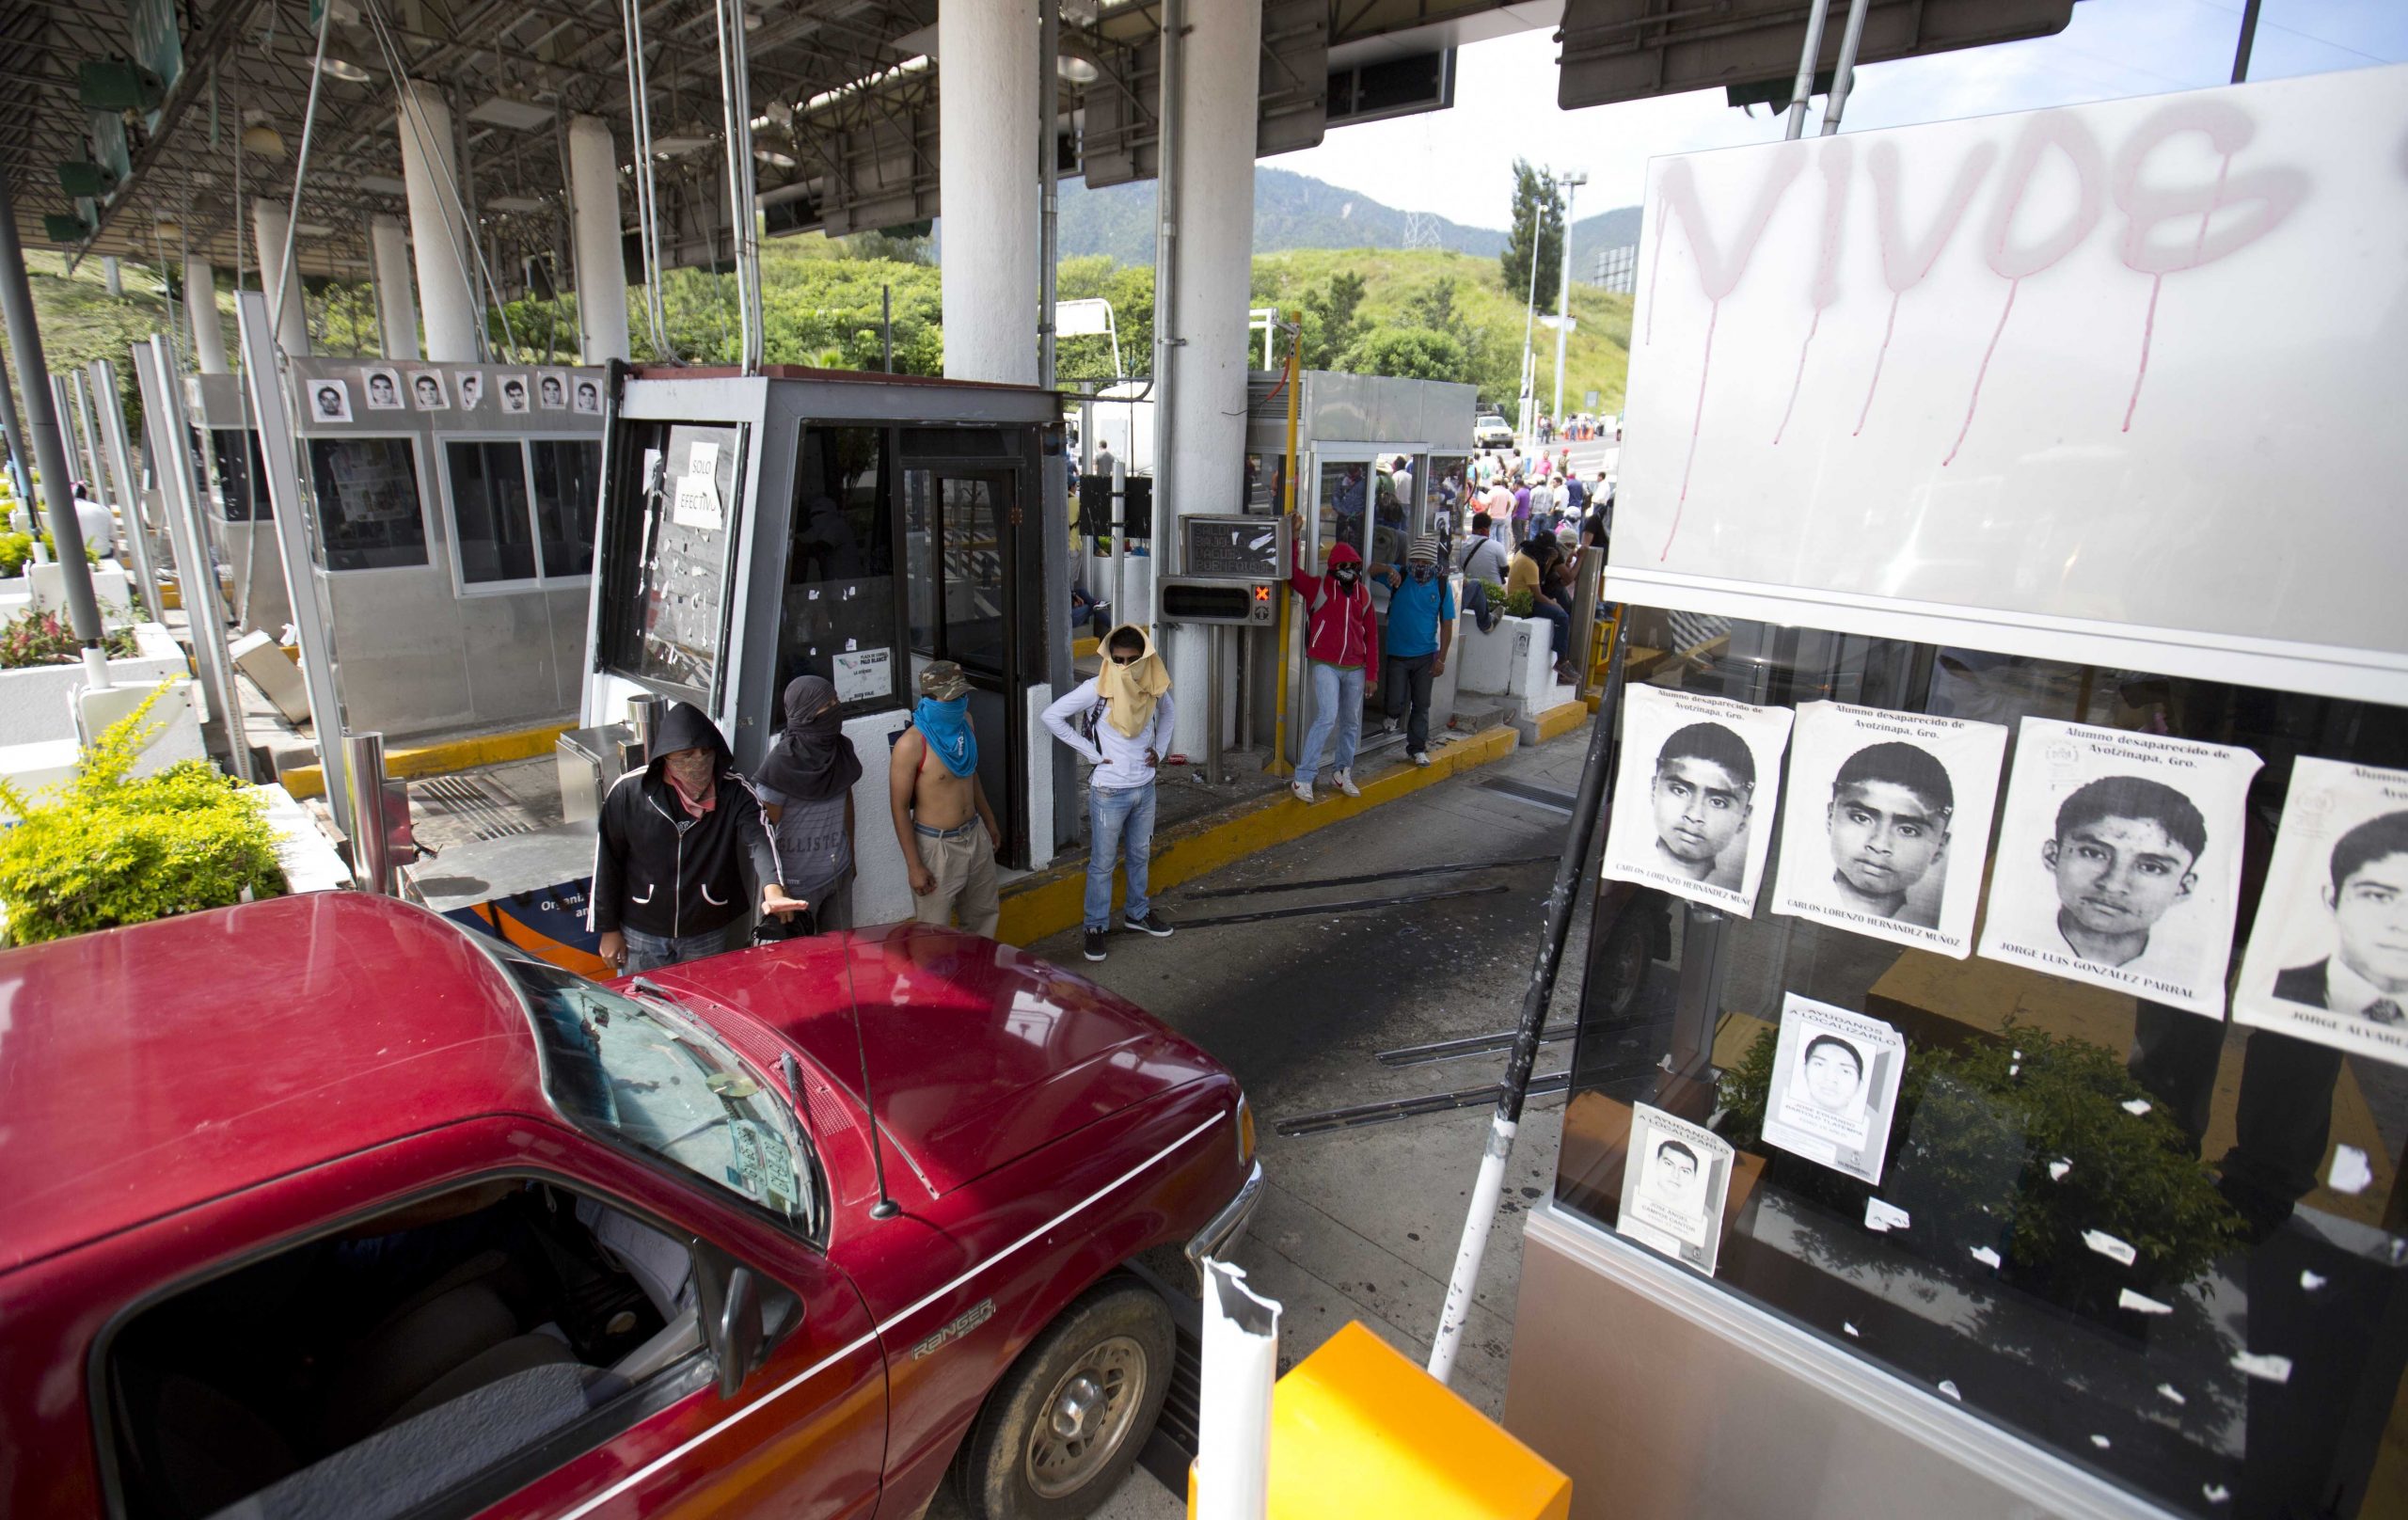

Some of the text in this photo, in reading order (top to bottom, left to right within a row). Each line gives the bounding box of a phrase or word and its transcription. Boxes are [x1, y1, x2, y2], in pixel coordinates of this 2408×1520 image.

[1657, 98, 2313, 309] VIVOS
[691, 459, 712, 475] SOLO
[1657, 689, 1690, 701] Alumno
[1691, 695, 1750, 712] desaparecido
[1726, 711, 1745, 720] Gro.
[1835, 705, 1965, 730] Alumno desaparecido de
[1917, 728, 1941, 739] Gro.
[2066, 727, 2230, 760] Alumno desaparecido de
[2168, 756, 2198, 769] Gro.
[776, 831, 847, 852] OLLISTE
[1615, 863, 1644, 876] CARLOS
[1646, 869, 1681, 885] LORENZO
[1787, 898, 1821, 913] CARLOS
[1823, 907, 1864, 923] LORENZO
[1925, 929, 1961, 947] MUÑOZ
[2000, 942, 2195, 999] JORGE LUIS GONZALEZ PARRAL
[1801, 1013, 1897, 1046] LOCALIZARLO
[1807, 1009, 1883, 1036] AYUDANOS
[2289, 1010, 2408, 1048] JORGE ALVARE
[1648, 1118, 1730, 1155] LOCALIZARLO
[1654, 1115, 1719, 1145] AYUDANOS
